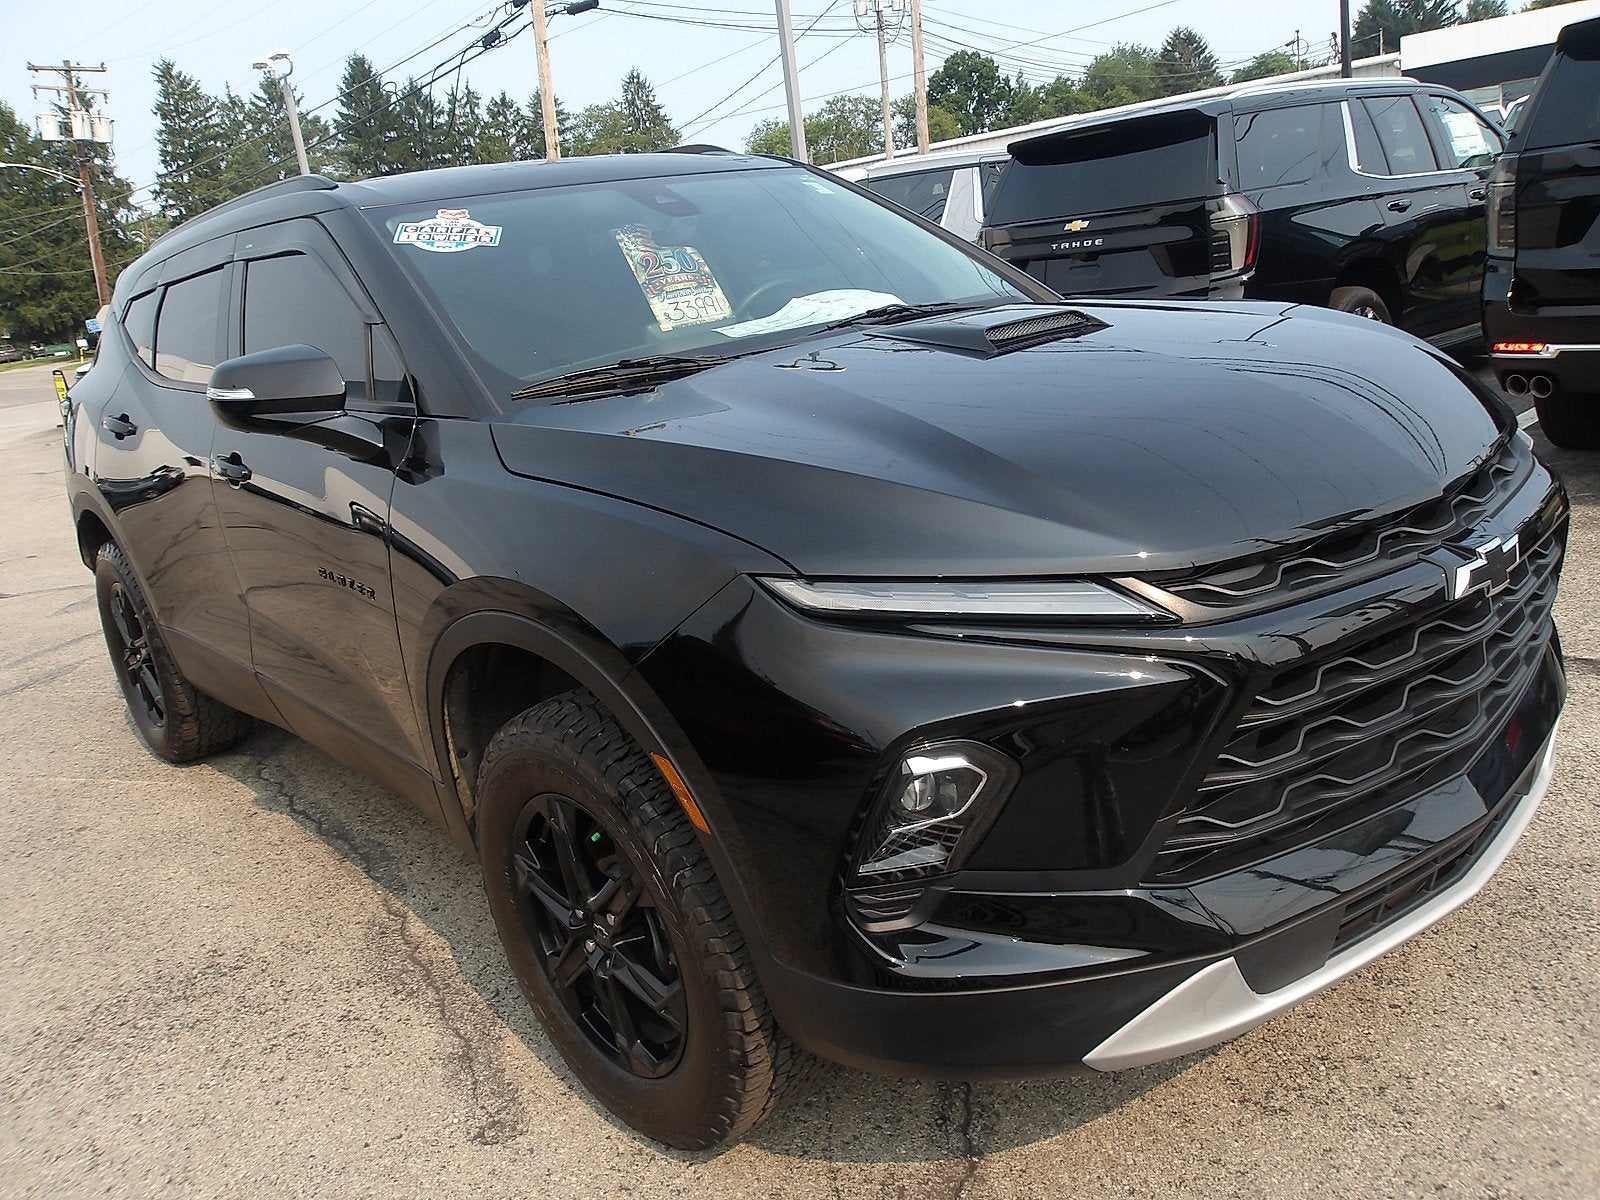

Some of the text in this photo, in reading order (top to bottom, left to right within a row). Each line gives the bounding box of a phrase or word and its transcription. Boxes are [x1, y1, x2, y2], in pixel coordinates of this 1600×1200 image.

[404, 225, 491, 235] CARFAX
[416, 233, 494, 243] OWNER
[1051, 239, 1104, 250] TAHOE
[640, 248, 698, 279] 250
[660, 275, 694, 284] YEARS
[318, 567, 376, 601] BLAZER
